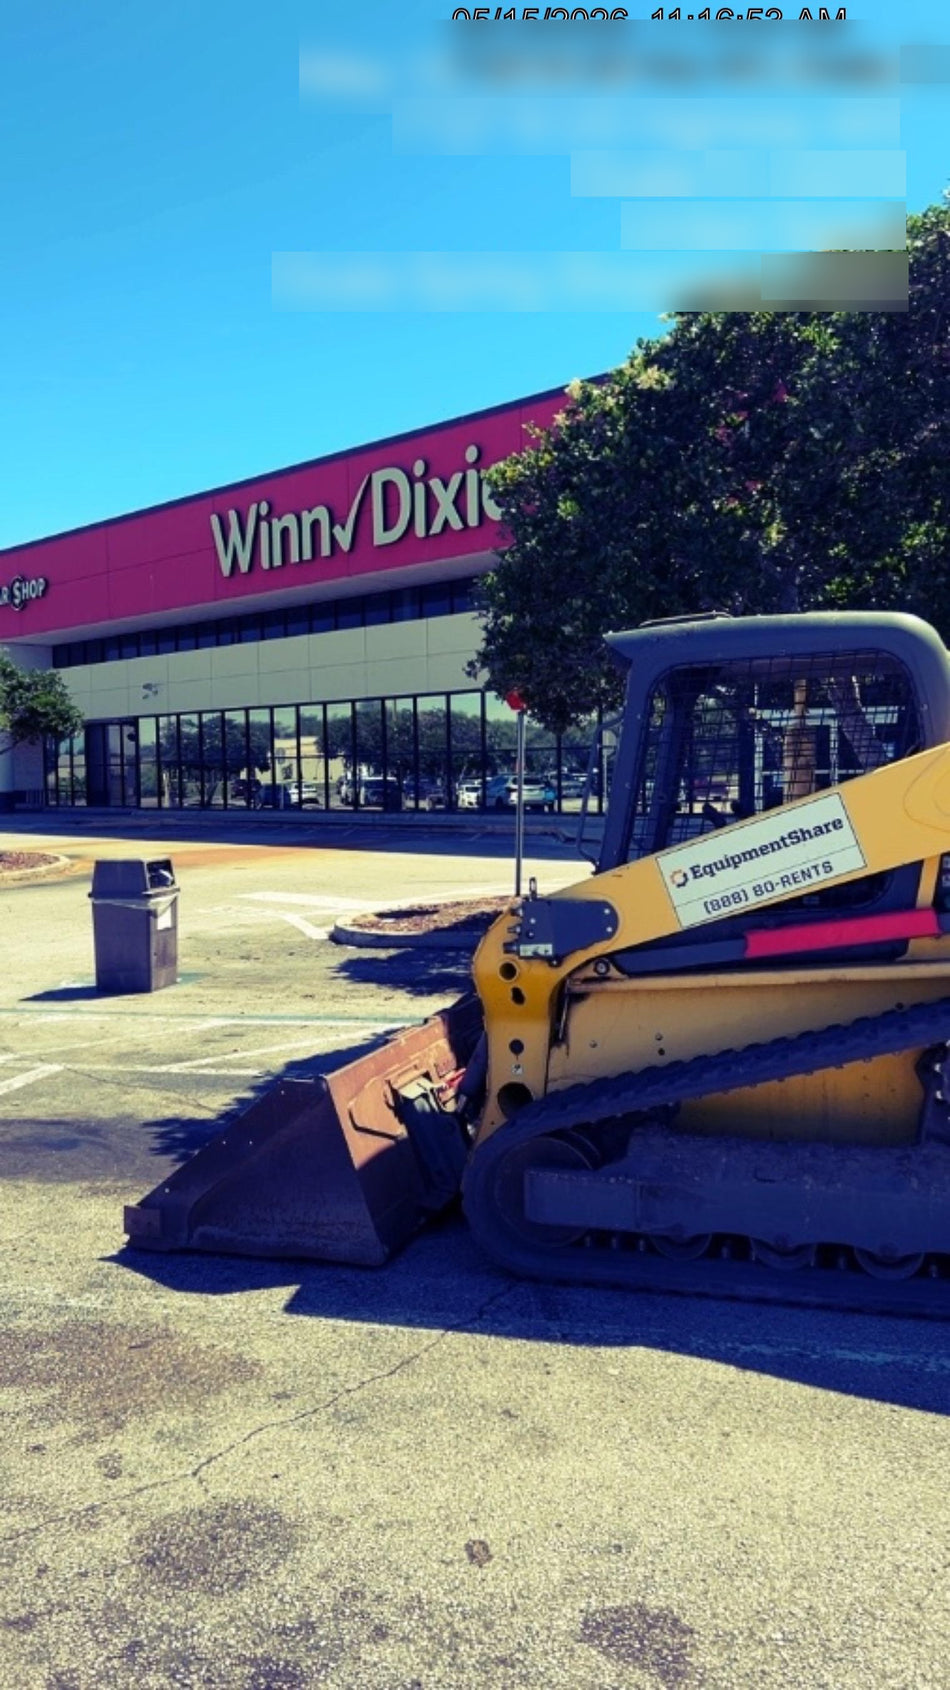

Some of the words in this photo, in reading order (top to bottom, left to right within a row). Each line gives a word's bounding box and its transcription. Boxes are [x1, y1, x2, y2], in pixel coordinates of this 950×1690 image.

[210, 500, 332, 577] Winn
[689, 817, 844, 880] EquipmentShare
[703, 889, 749, 915] (888)
[752, 860, 834, 897] 80-RENTS
